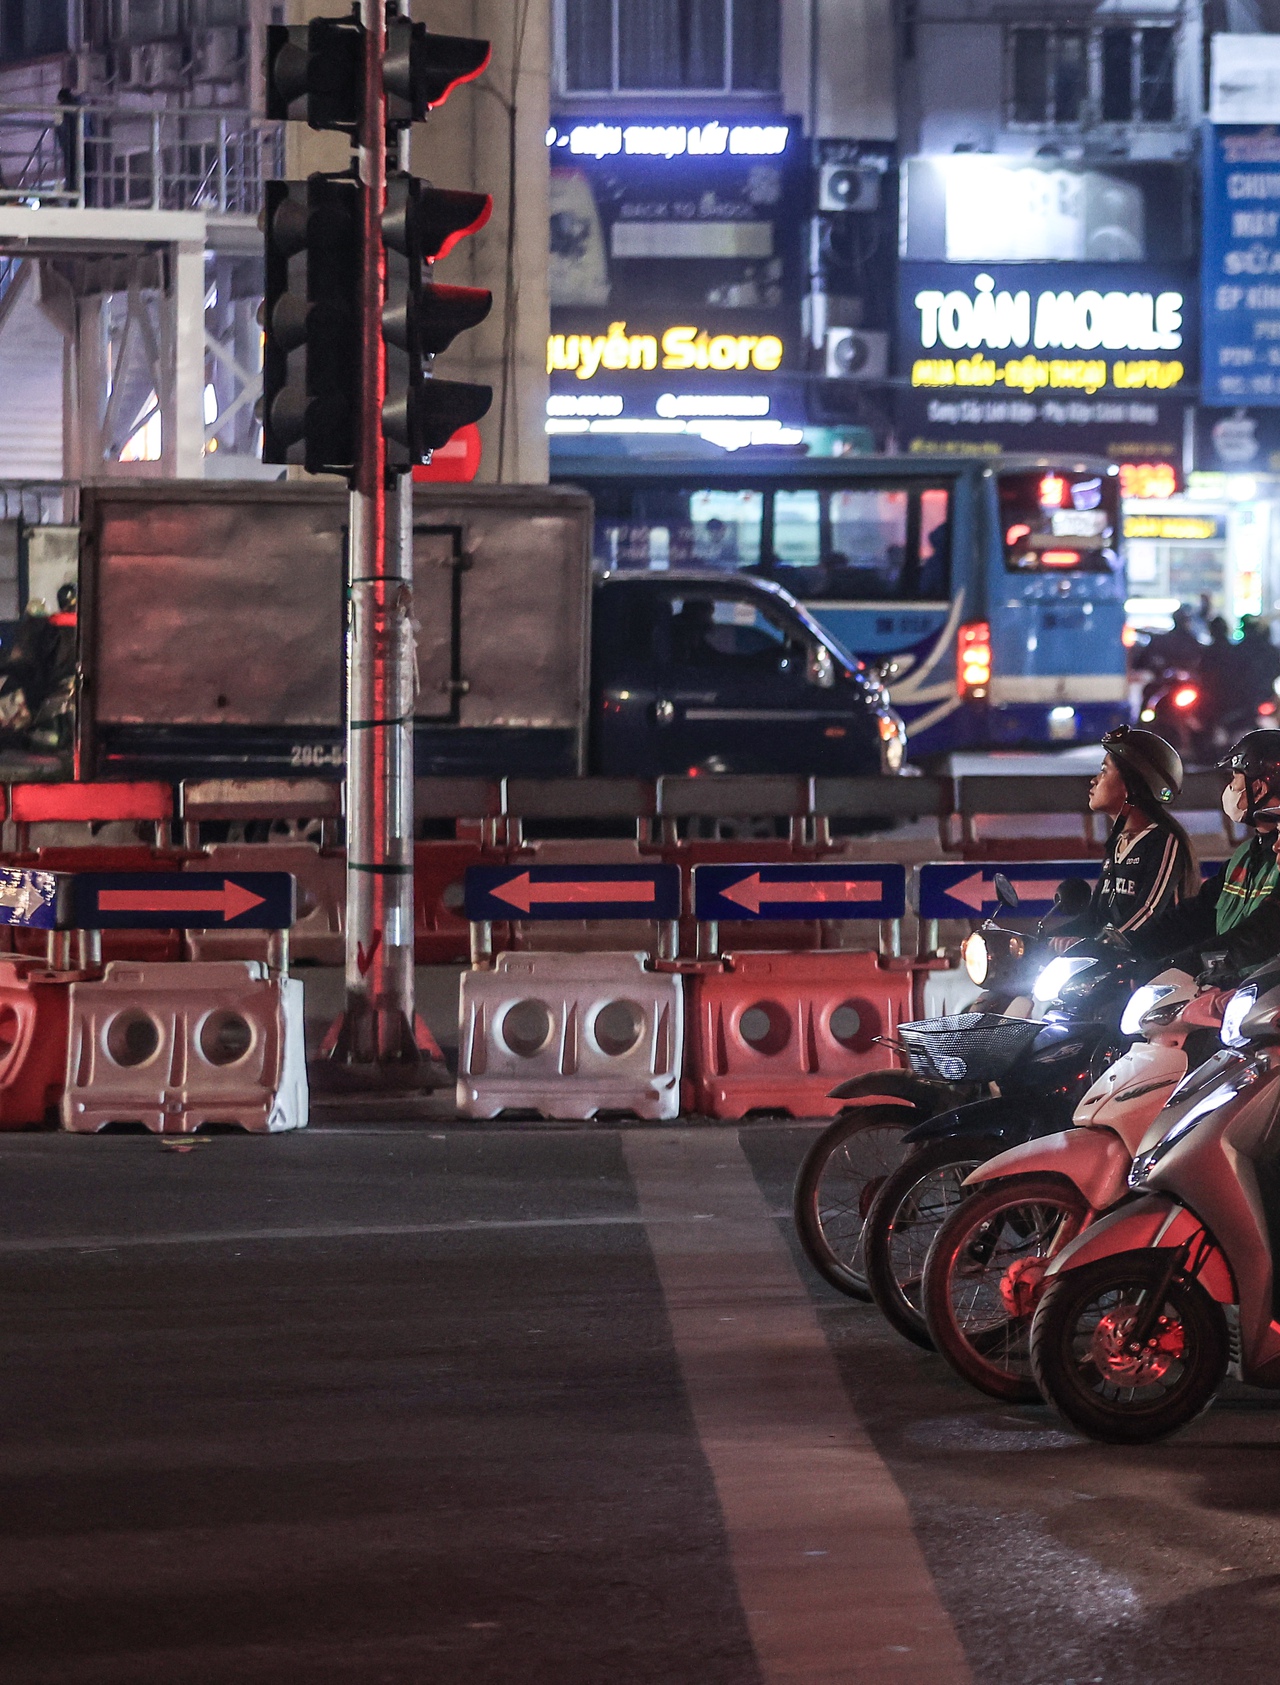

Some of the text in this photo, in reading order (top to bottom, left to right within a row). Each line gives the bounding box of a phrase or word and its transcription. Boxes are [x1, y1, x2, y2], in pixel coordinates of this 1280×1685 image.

[1033, 290, 1184, 350] MOBILE
[547, 321, 783, 380] uyễn Store
